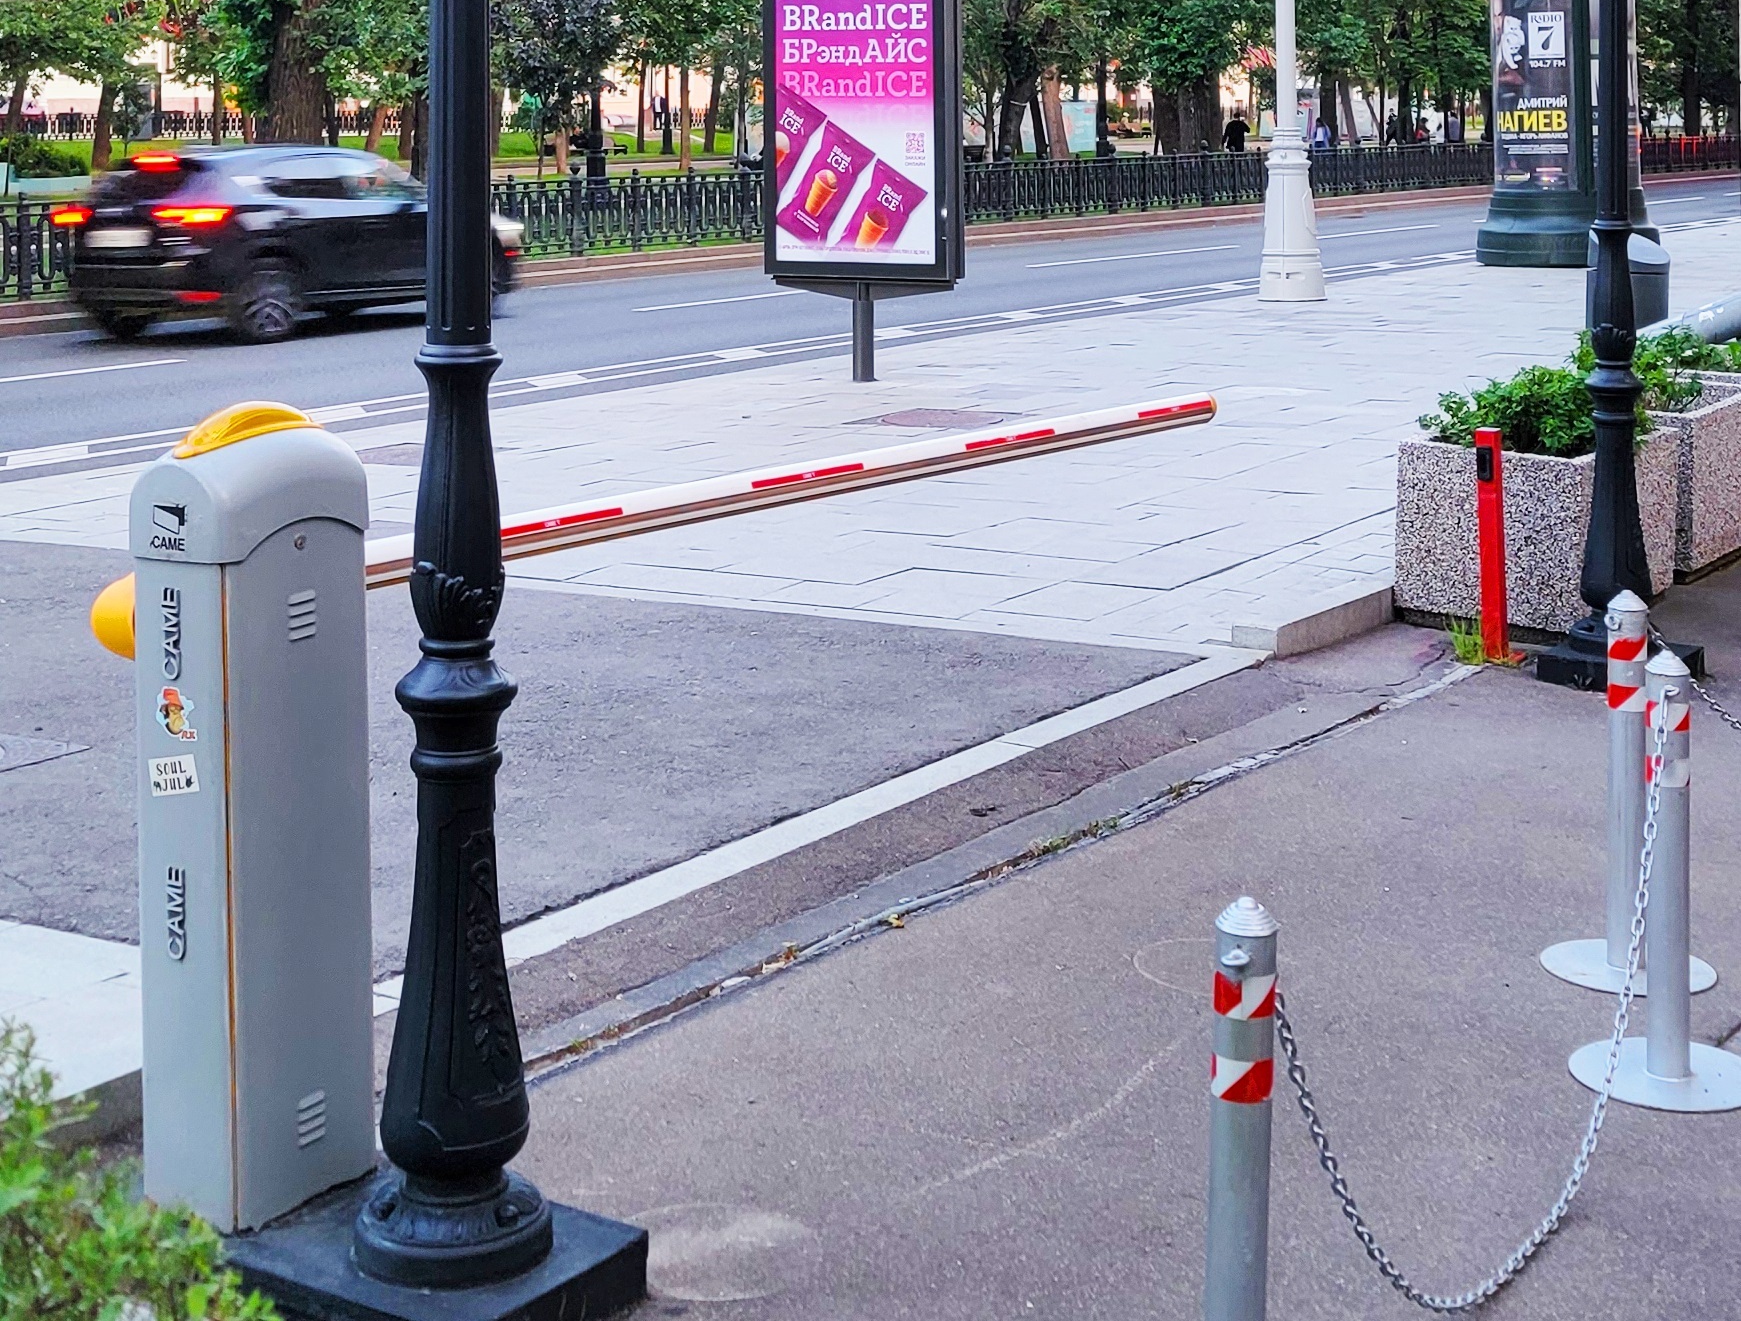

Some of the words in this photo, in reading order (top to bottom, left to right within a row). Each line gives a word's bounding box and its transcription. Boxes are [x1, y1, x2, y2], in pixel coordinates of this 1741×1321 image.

[782, 3, 928, 31] BRandICE
[1530, 13, 1562, 24] RADIO
[1537, 25, 1554, 51] 7
[782, 32, 928, 67] БРэндАЙС
[1528, 60, 1551, 69] 104.7
[1553, 59, 1566, 68] FM
[782, 70, 928, 98] BRandICE
[1516, 94, 1568, 110] ДМИТРИЙ
[779, 114, 801, 135] ICE
[1496, 110, 1568, 132] НАГИЕВ
[827, 152, 849, 173] ICE
[877, 190, 900, 211] ICE
[150, 535, 186, 552] CAME
[161, 587, 181, 681] CAME
[156, 760, 187, 777] SOUL
[166, 866, 187, 961] CAME
